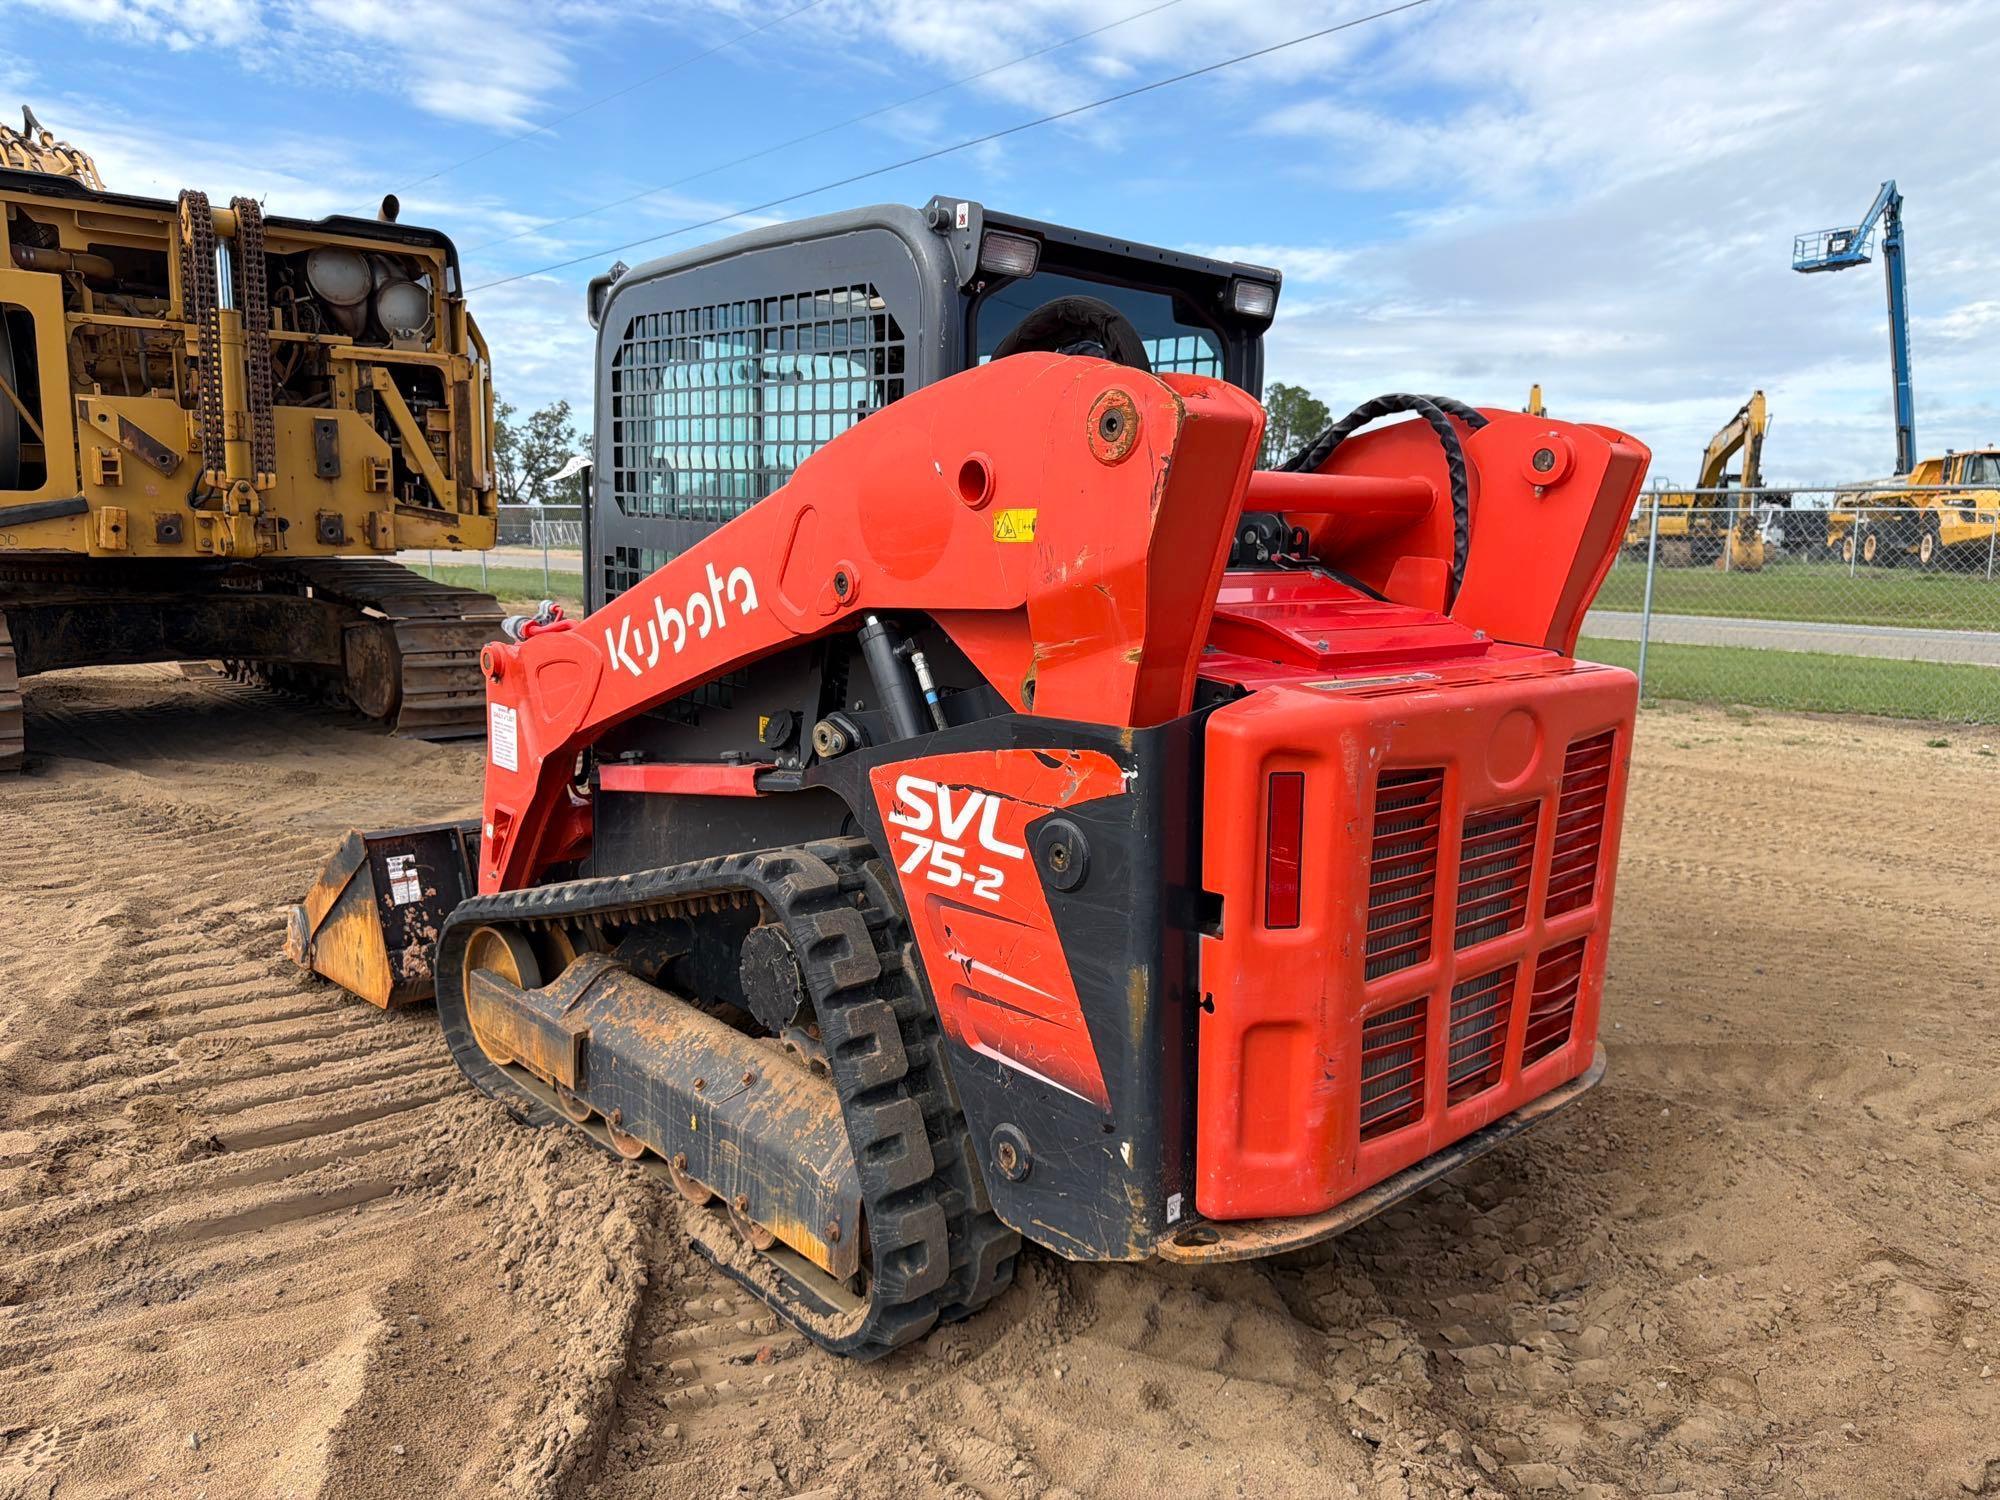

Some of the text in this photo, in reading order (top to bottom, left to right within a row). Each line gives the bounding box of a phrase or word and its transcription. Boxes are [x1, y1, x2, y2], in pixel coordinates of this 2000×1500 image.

[604, 562, 759, 677] Kubota
[888, 774, 1026, 860] SVL
[899, 831, 1005, 902] 75-2
